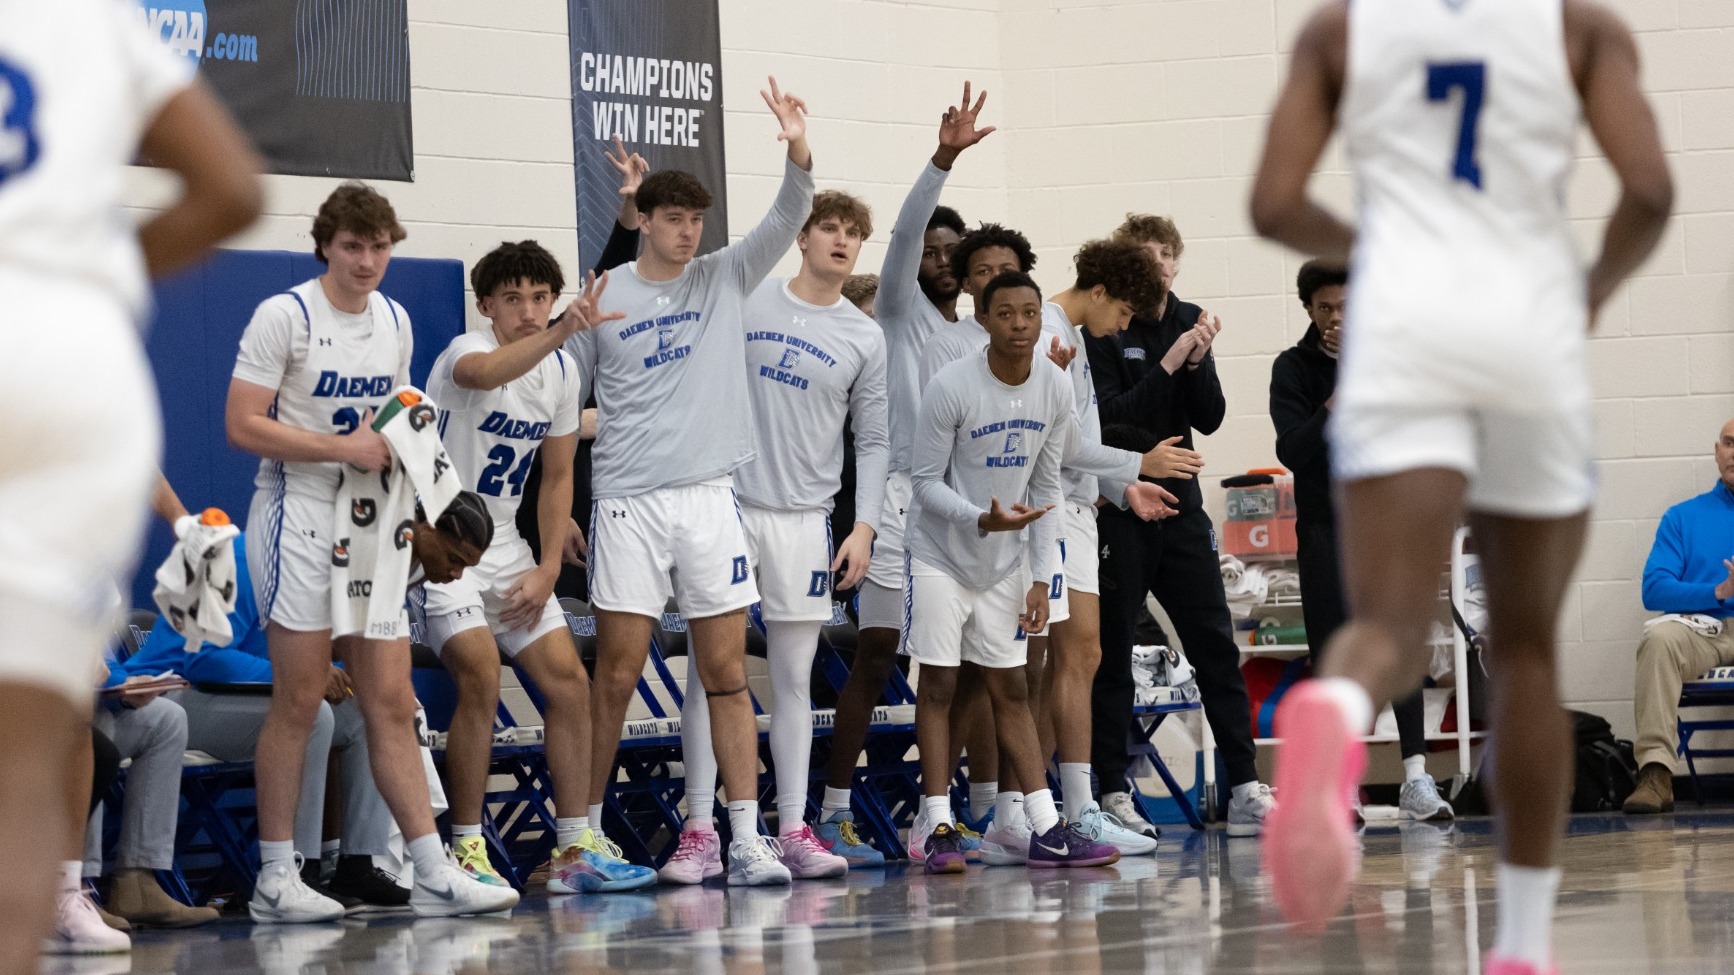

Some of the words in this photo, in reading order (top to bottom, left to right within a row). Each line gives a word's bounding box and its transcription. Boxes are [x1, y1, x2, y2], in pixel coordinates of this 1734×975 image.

[206, 32, 258, 62] .com
[580, 52, 713, 101] CHAMPIONS
[593, 101, 639, 142] WIN
[645, 105, 701, 147] HERE
[1425, 61, 1485, 190] 7
[619, 319, 655, 341] DAEMEN
[643, 345, 691, 369] WILDCATS
[746, 331, 785, 342] DAEMEN
[786, 335, 837, 368] UNIVERSITY
[759, 365, 809, 390] WILDCATS
[332, 406, 379, 436] 2
[476, 410, 552, 441] DAEME
[970, 422, 1006, 439] DAEMEN
[476, 443, 536, 497] 24
[1101, 544, 1110, 559] 4
[1249, 525, 1269, 548] G
[627, 722, 658, 736] WILDCATS
